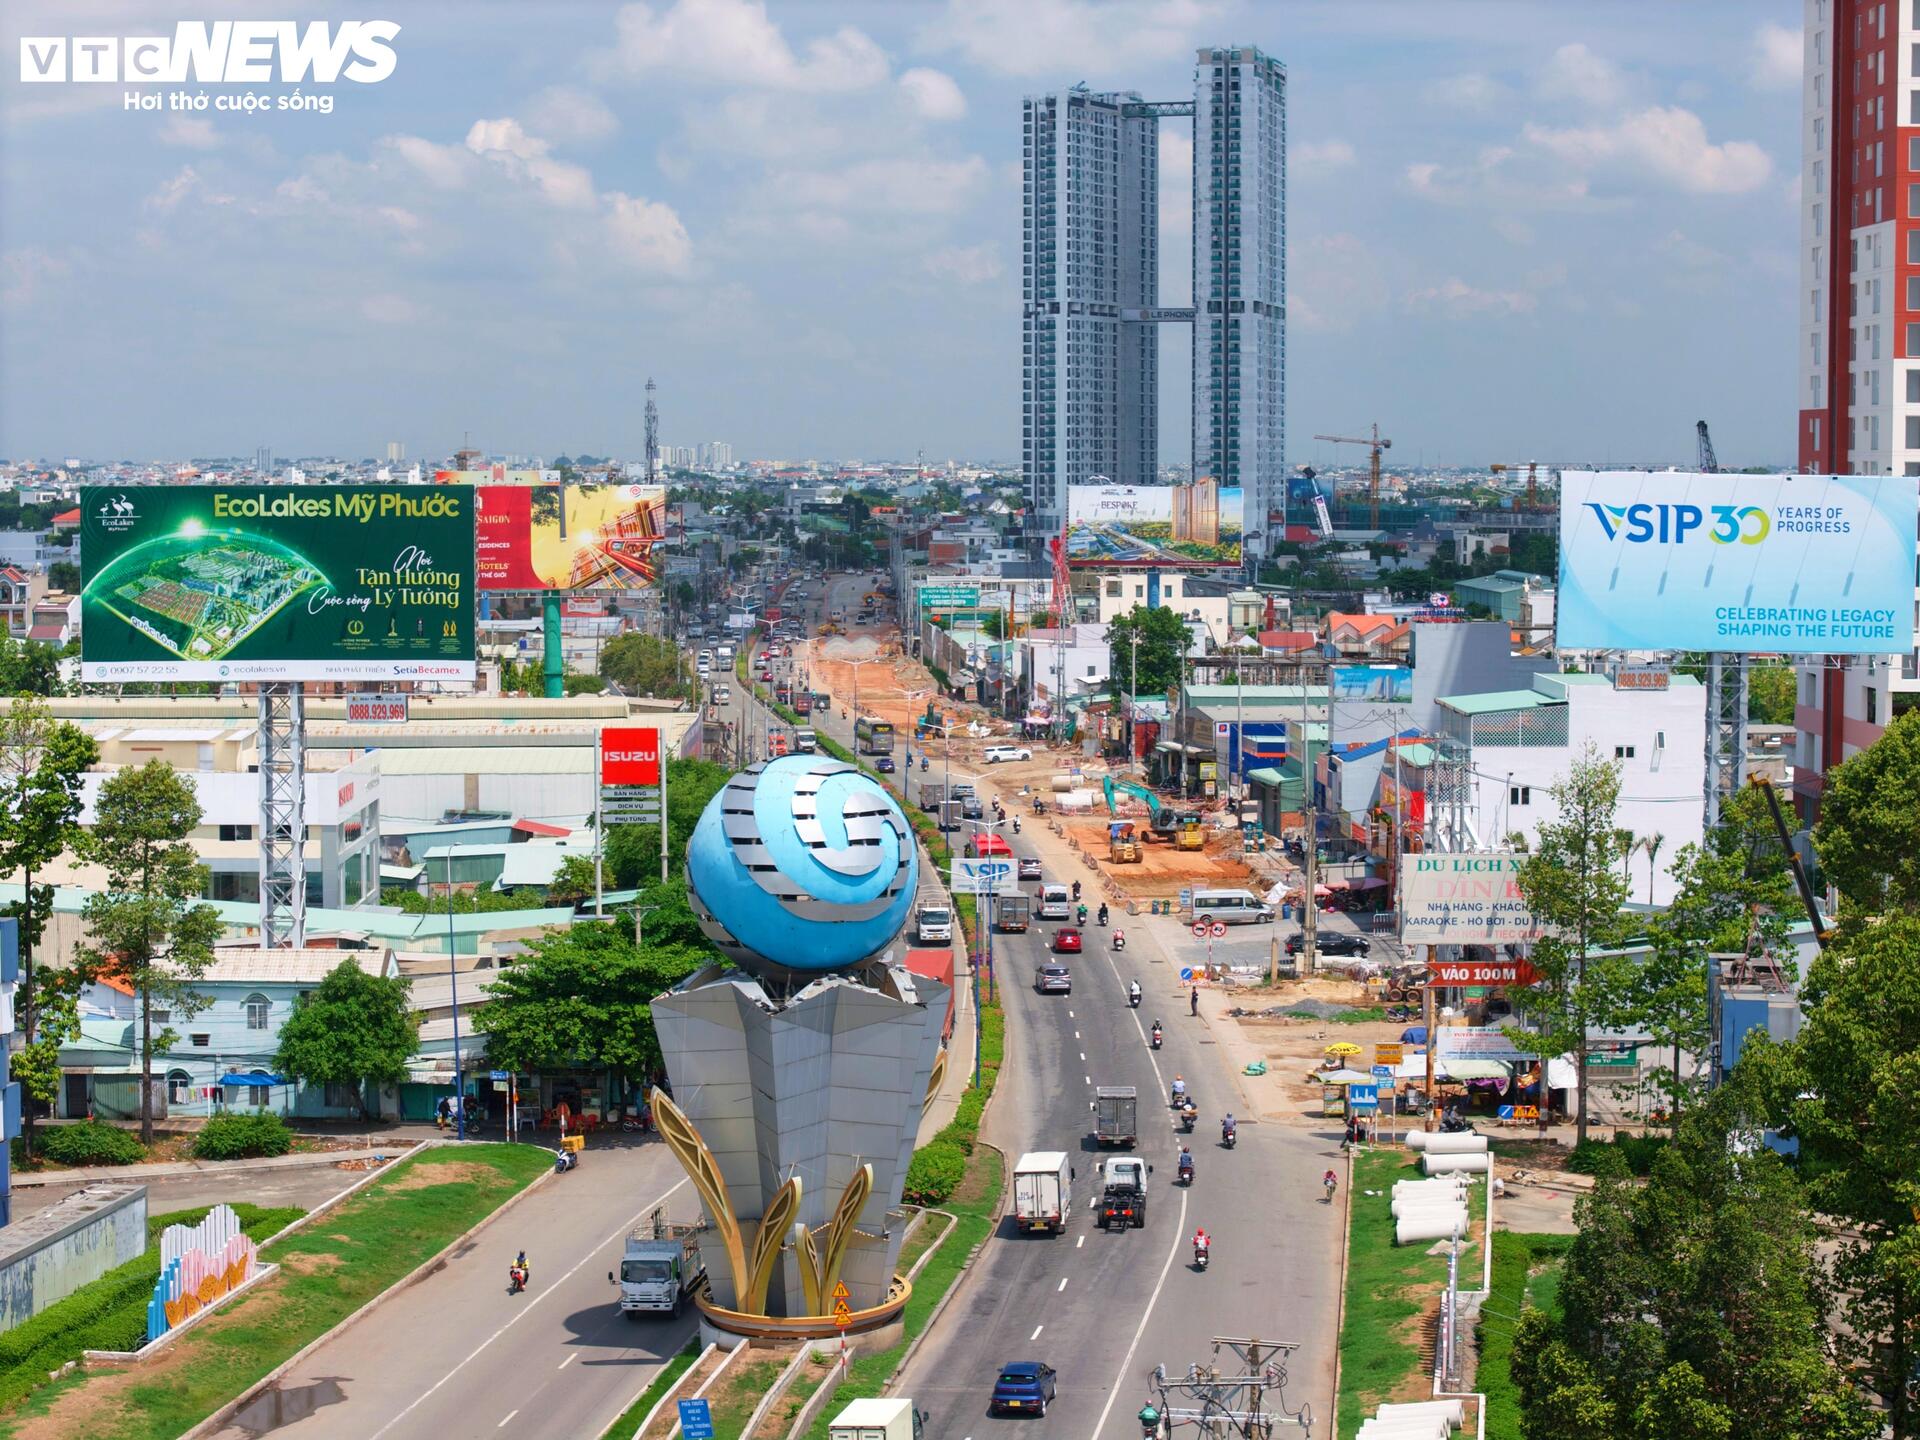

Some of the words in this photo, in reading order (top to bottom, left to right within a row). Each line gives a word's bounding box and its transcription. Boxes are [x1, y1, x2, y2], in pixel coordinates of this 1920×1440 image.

[214, 493, 331, 517] EcoLakes
[335, 494, 376, 523] Mỹ
[380, 492, 460, 517] Phước
[1777, 507, 1821, 519] YEARS
[1826, 507, 1843, 519] OF
[1581, 503, 1703, 543] VSIP
[1709, 505, 1770, 545] 30
[1777, 521, 1850, 533] PROGRESS
[393, 545, 433, 574] Nơi
[356, 568, 390, 588] Tận
[396, 568, 460, 590] Hưởng
[375, 588, 395, 608] Lý
[399, 588, 460, 609] Tưởng
[1716, 607, 1827, 622] CELEBRATING
[1831, 609, 1895, 622] LEGACY
[1718, 623, 1791, 637] SHAPING
[1795, 624, 1826, 637] THE
[1832, 625, 1895, 638] FUTURE
[393, 665, 460, 675] SetiaBecamex
[1617, 672, 1668, 688] 0888.929.969
[349, 703, 405, 720] 0888.929.969
[604, 751, 656, 762] ISUZU
[960, 863, 1010, 880] VSIP
[1417, 859, 1445, 872] DU
[1452, 859, 1502, 874] LỊCH
[1427, 901, 1450, 911] NHÀ
[1453, 901, 1483, 912] HÀNG
[1405, 917, 1458, 926] KARAOKE
[1514, 917, 1529, 926] DU
[1441, 965, 1469, 980] VÀO
[1473, 968, 1516, 980] 100M
